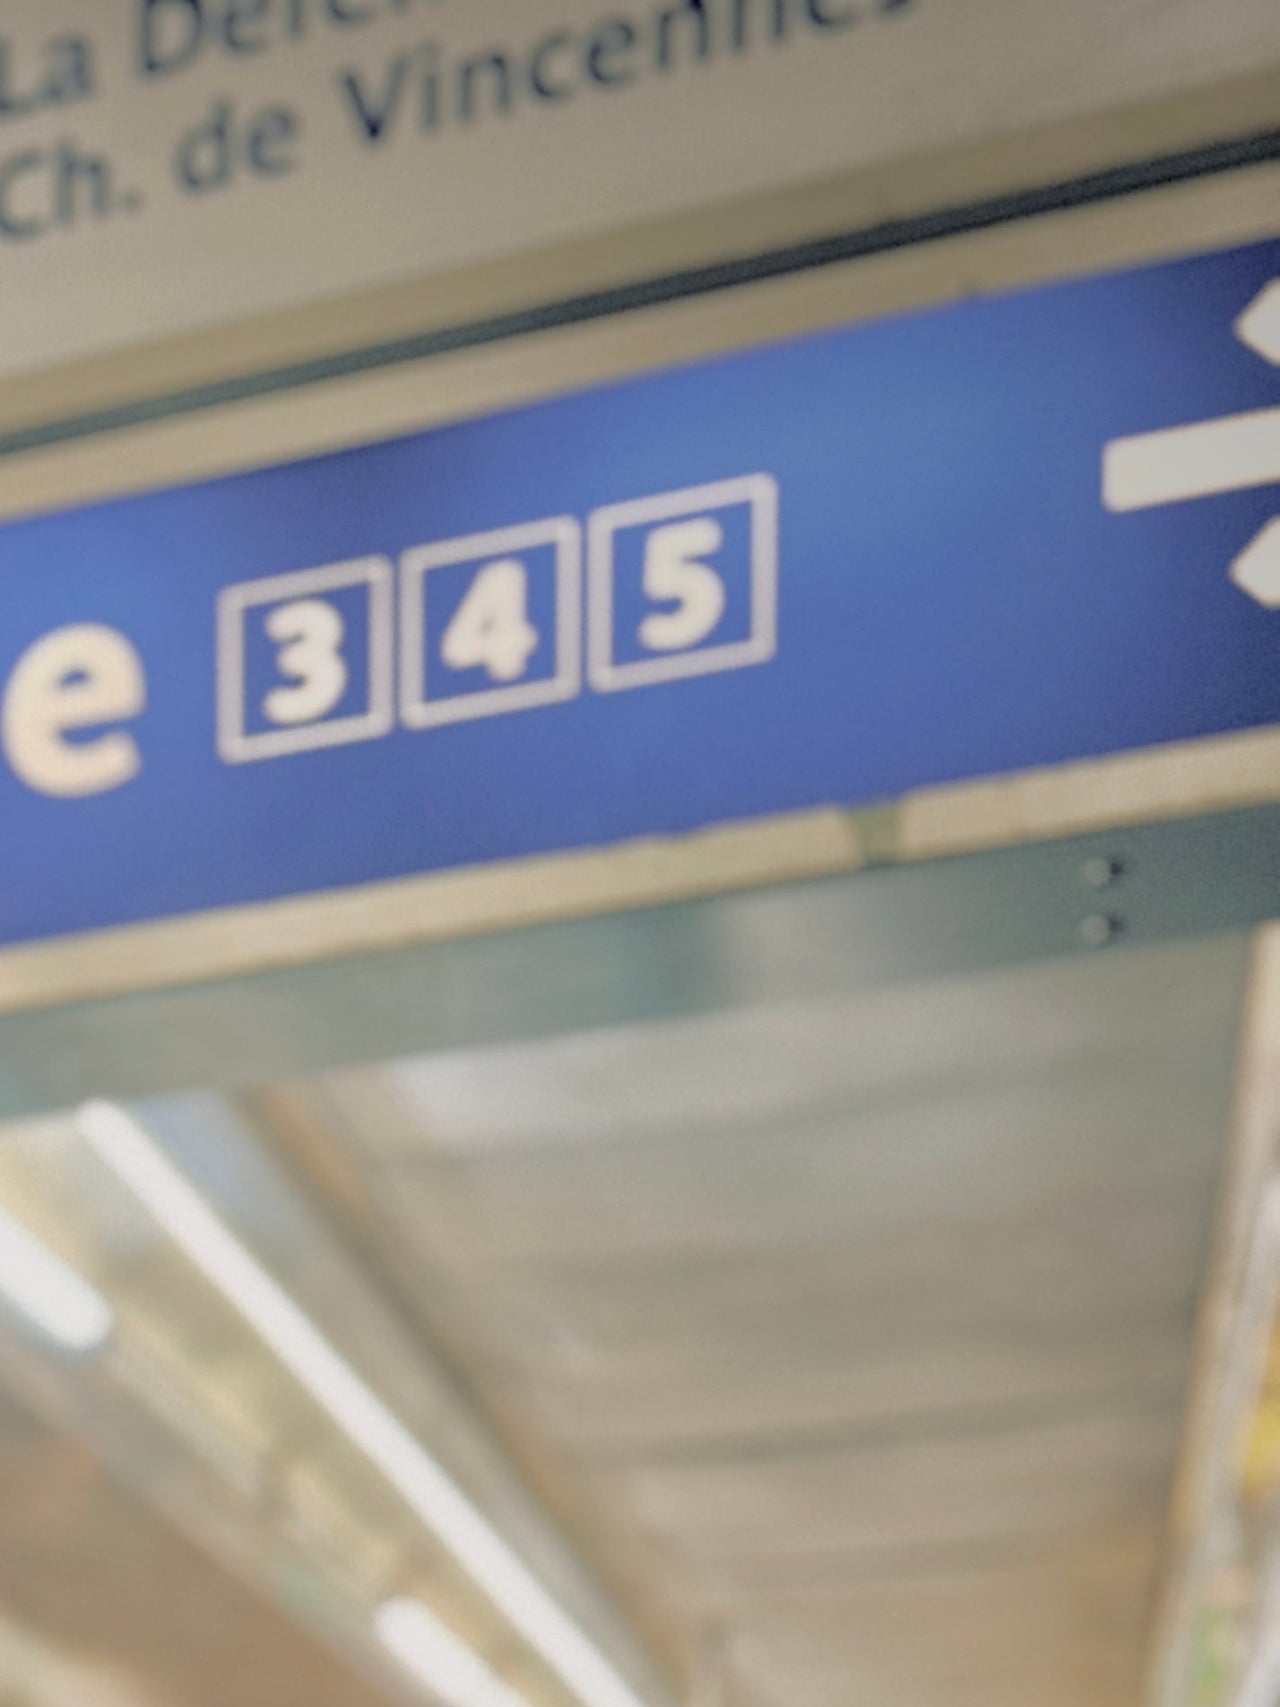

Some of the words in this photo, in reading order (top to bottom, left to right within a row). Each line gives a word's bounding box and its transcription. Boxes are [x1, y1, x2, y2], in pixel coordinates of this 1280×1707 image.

[175, 98, 298, 193] de
[262, 599, 347, 726] 3
[441, 557, 539, 682] 4
[636, 516, 726, 652] 5
